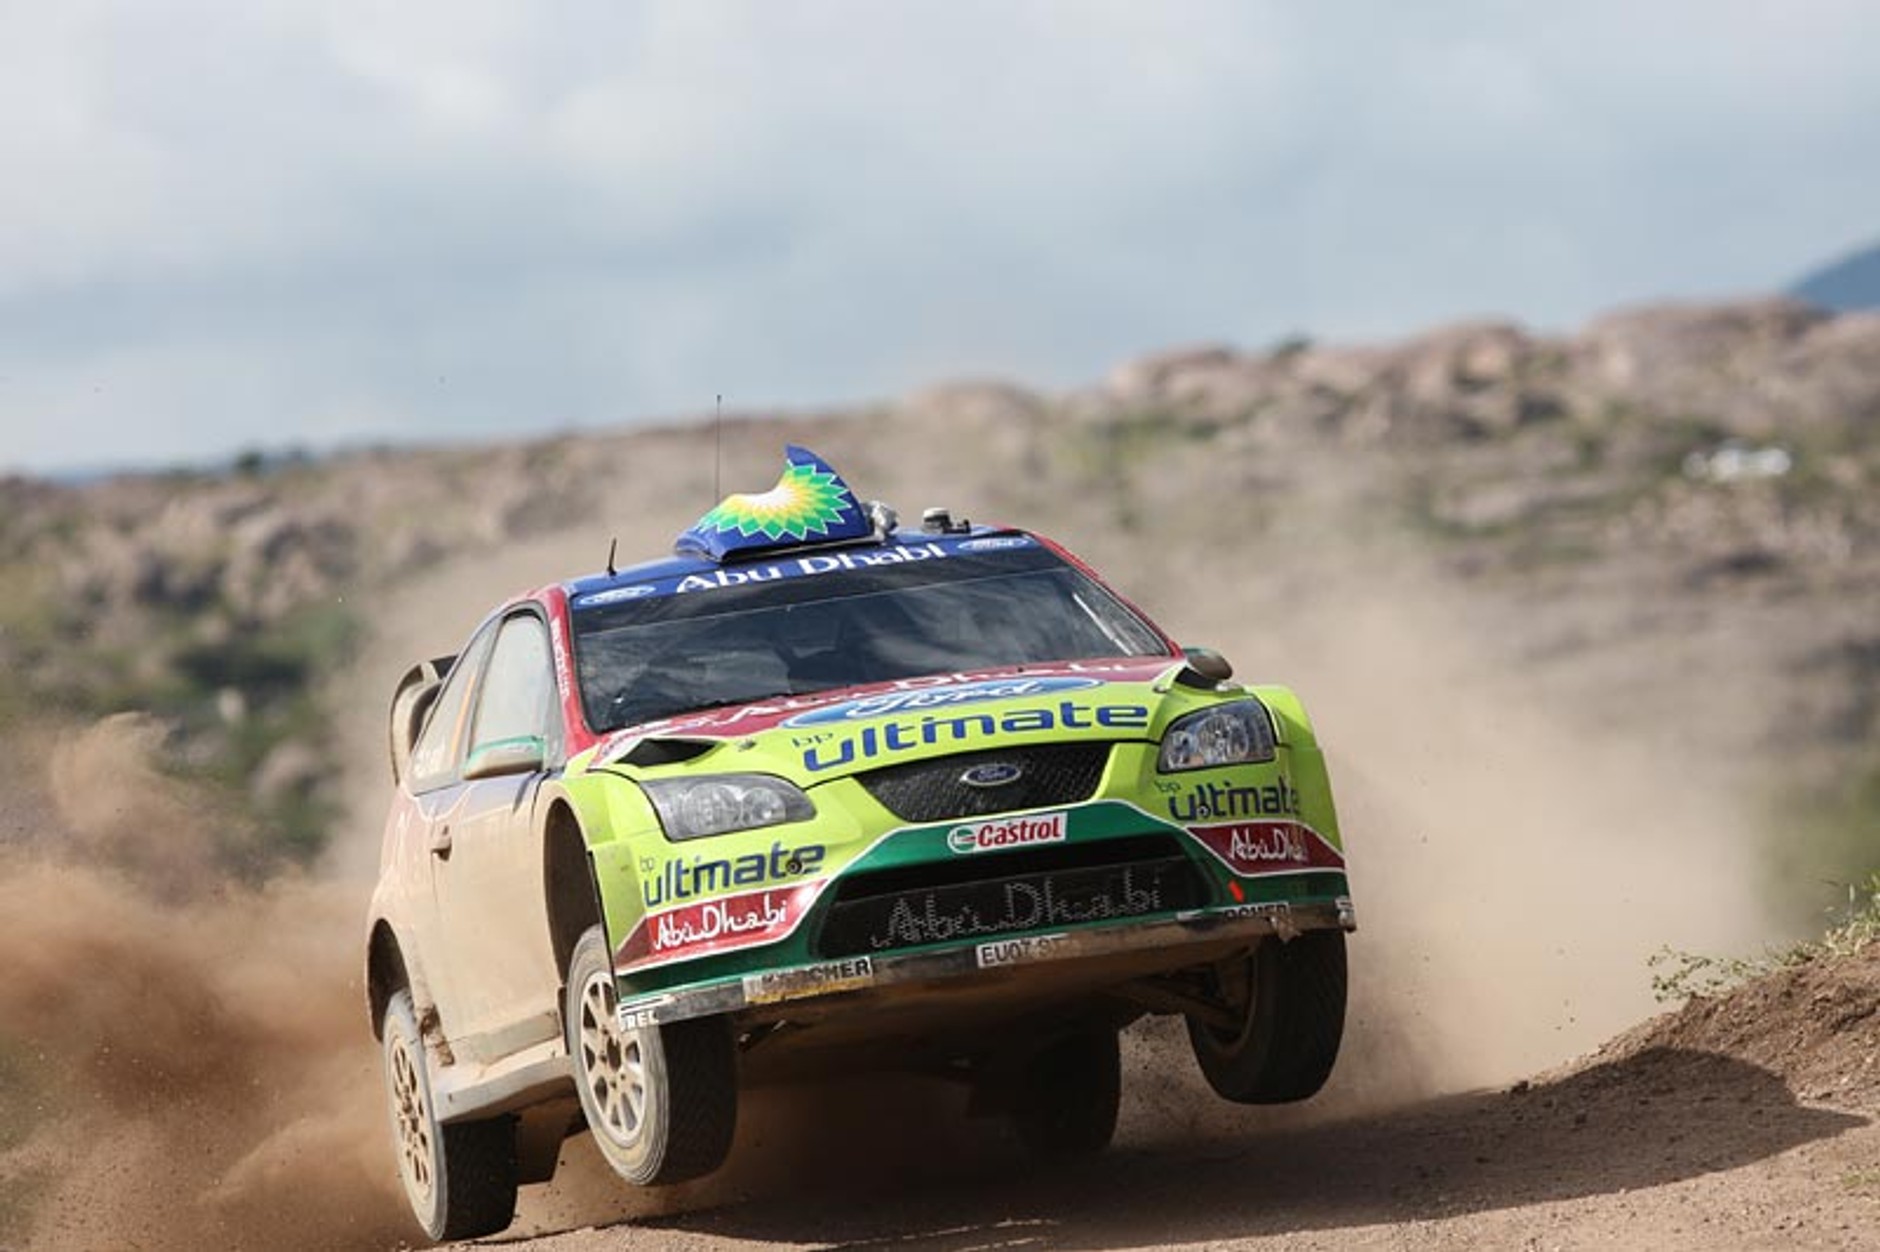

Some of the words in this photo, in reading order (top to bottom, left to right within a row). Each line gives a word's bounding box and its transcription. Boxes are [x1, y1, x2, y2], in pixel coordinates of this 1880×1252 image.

[676, 566, 783, 593] Abu
[846, 679, 1046, 717] Ford
[803, 702, 1149, 772] ultimate
[977, 815, 1062, 848] Castrol
[643, 841, 826, 908] ultimate
[1002, 867, 1163, 925] Dhabi
[653, 912, 700, 950] Abu
[700, 892, 788, 940] Dhabi
